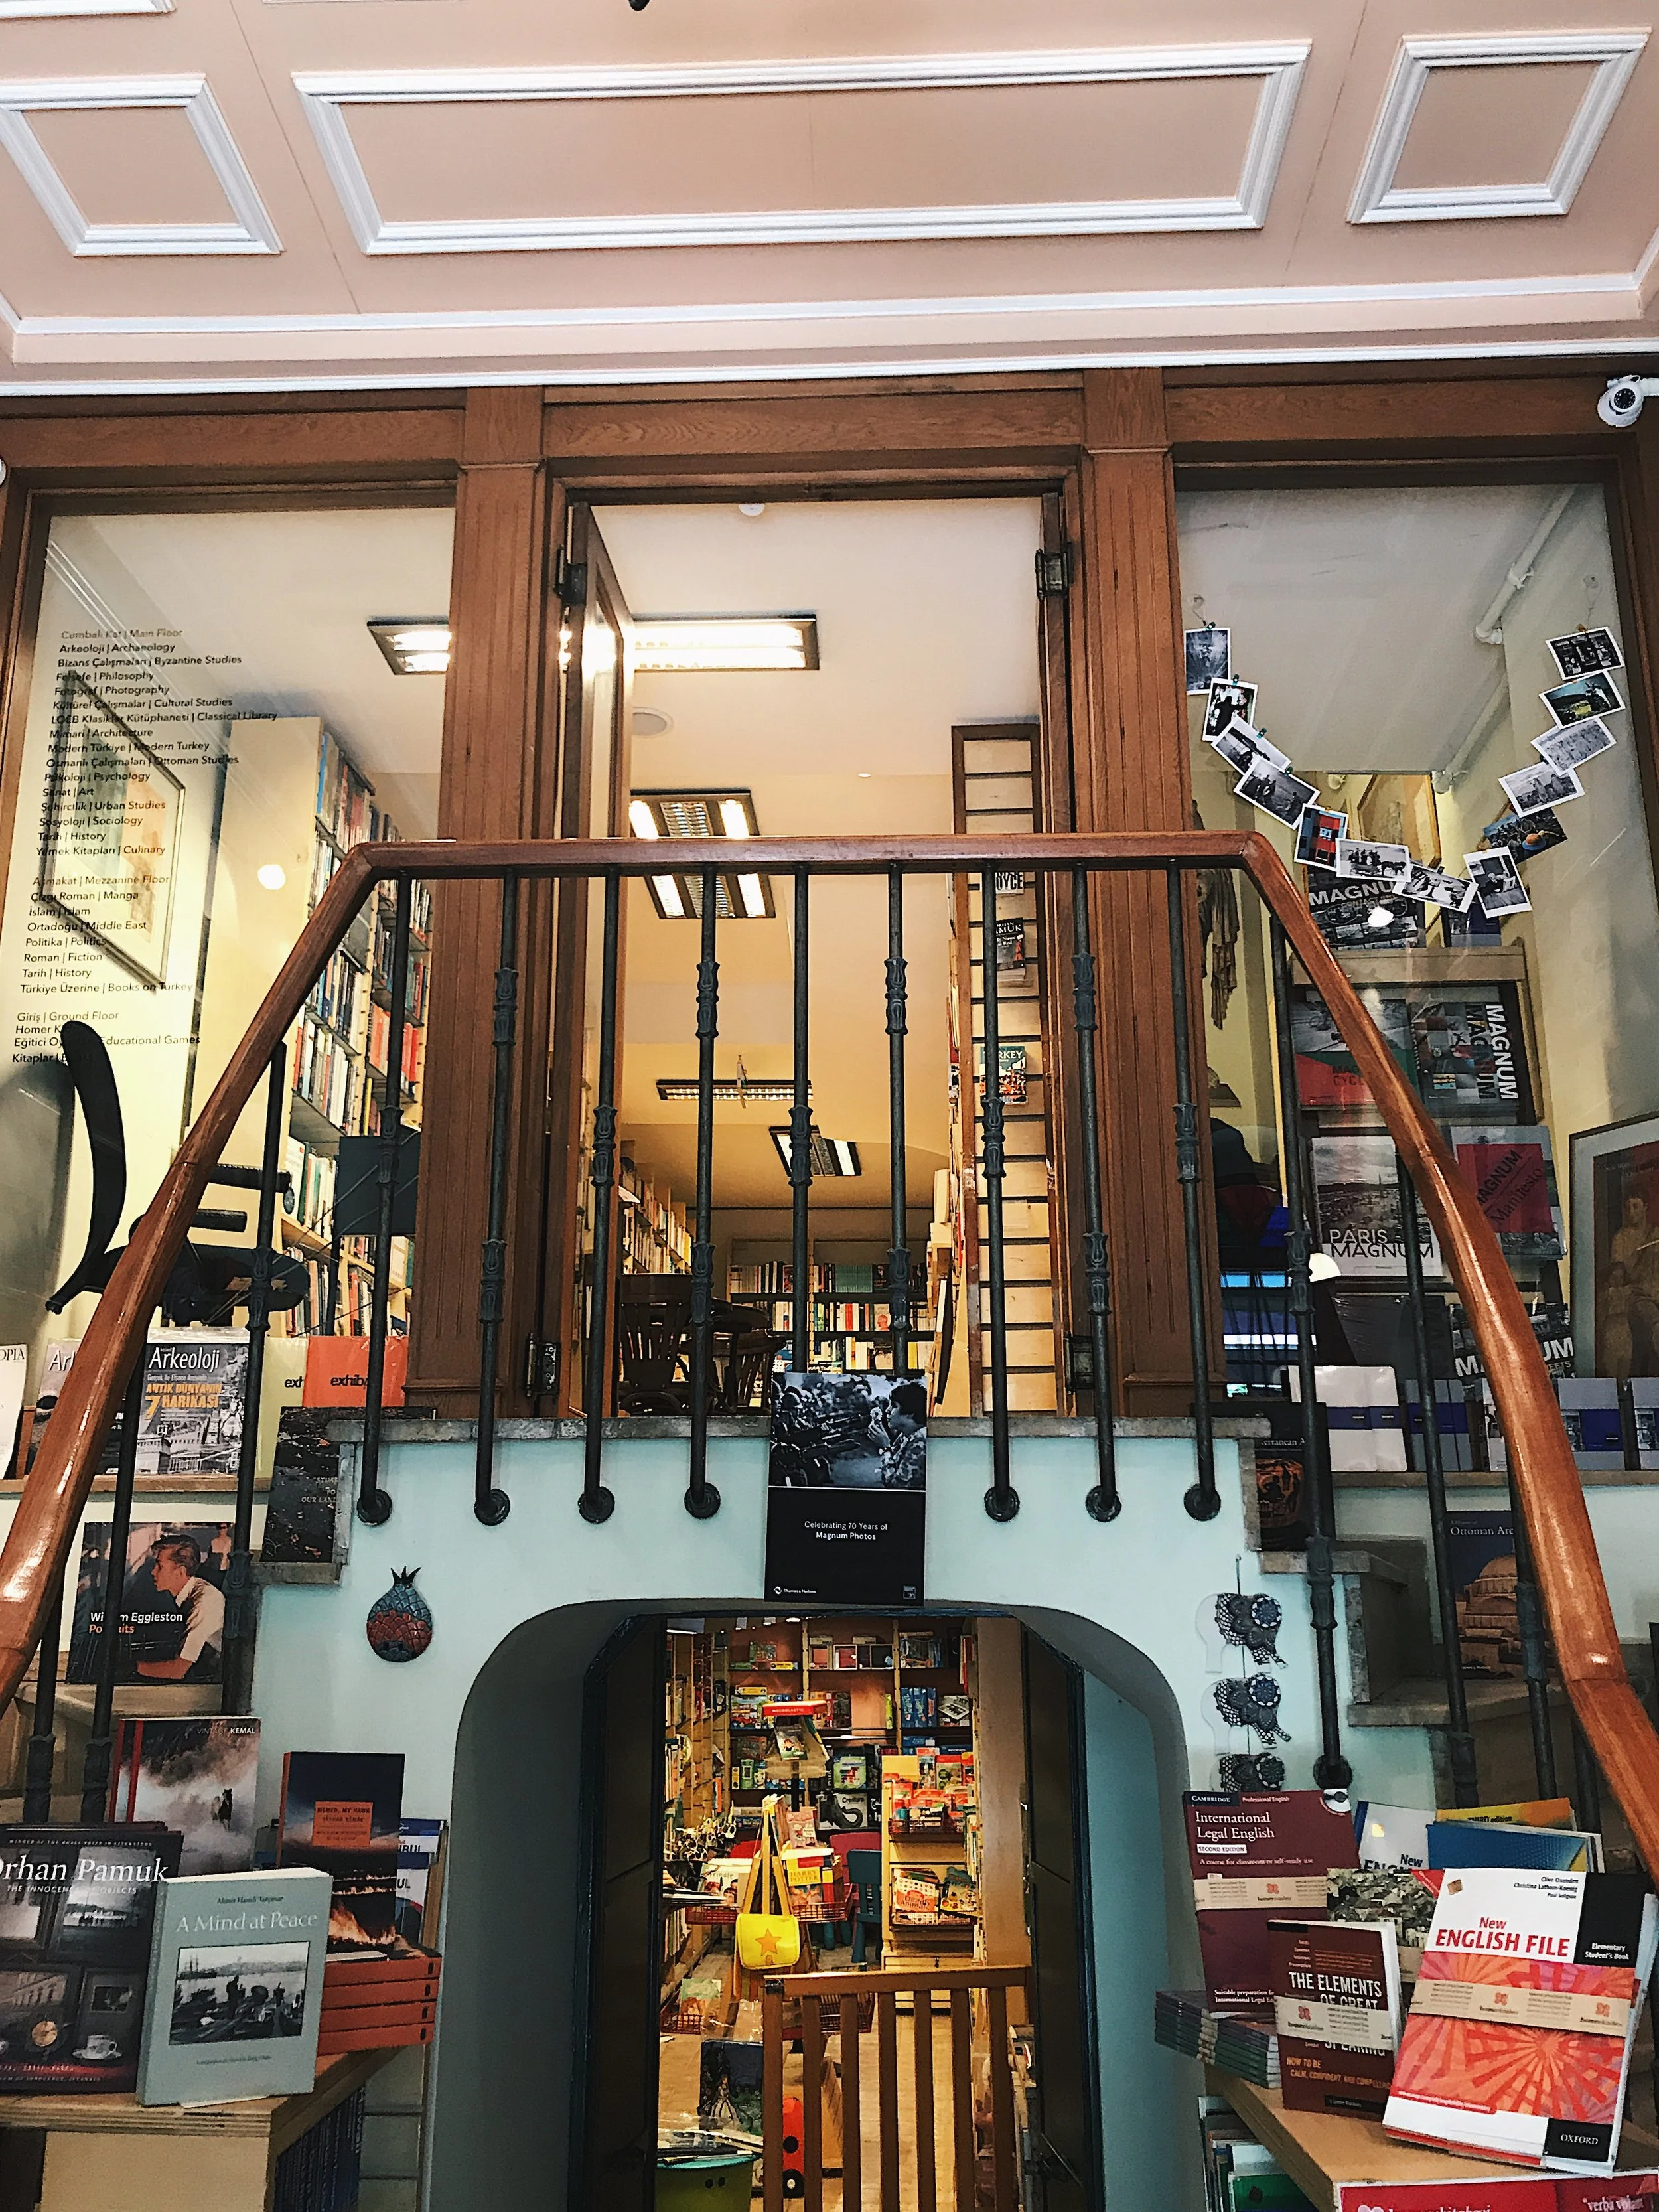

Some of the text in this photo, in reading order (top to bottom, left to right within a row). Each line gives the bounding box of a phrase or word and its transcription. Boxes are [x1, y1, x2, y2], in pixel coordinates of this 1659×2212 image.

[157, 628, 182, 637] Floor
[59, 645, 105, 654] Arkeoloji
[58, 658, 89, 667] Bizans
[155, 657, 202, 667] Byzantine
[100, 672, 154, 682] Philosophy
[105, 685, 170, 696] Photography
[154, 698, 193, 707] Cultural
[196, 698, 233, 707] Studies
[197, 712, 240, 721] Classical
[243, 710, 277, 721] Library
[92, 729, 153, 738] Architecture
[177, 741, 209, 751] Turkey
[155, 756, 198, 765] Ottoman
[202, 754, 239, 764] Studies
[94, 772, 150, 783] Psychology
[78, 788, 94, 796] Art
[94, 801, 125, 810] Urban
[128, 800, 165, 810] Studies
[39, 816, 143, 827] Sosyoloji Sociology
[71, 831, 106, 842] History
[123, 845, 165, 857] Culinary
[85, 876, 139, 885] Mezzanine
[142, 875, 170, 884] Floor
[60, 891, 96, 901] Roman
[104, 891, 139, 901] Manga
[1309, 881, 1394, 906] MAGNU
[86, 921, 147, 930] Middle East
[25, 936, 106, 947] Politika Politics
[24, 952, 102, 962] Roman Fiction
[22, 968, 92, 980] Tarih History
[21, 981, 194, 995] Türkiye Üzerine Books on Turkey
[17, 1011, 119, 1024] Giriş Ground Floor
[15, 1025, 52, 1035] Homer
[14, 1037, 46, 1049] Eğitici
[164, 1035, 200, 1045] Games
[1485, 1005, 1519, 1099] MAGNUM
[13, 1053, 54, 1065] Kitaplar
[1490, 1168, 1543, 1225] Manifesto
[1329, 1229, 1388, 1244] PARIS
[148, 1347, 220, 1372] Arkeoloji
[144, 1395, 161, 1420] 7
[804, 1520, 847, 1530] Celebrating
[816, 1531, 876, 1540] Magnum Photos
[1451, 1526, 1494, 1536] Ottoman
[131, 1612, 183, 1623] Eggleston
[1196, 1811, 1271, 1824] International
[1197, 1827, 1275, 1842] Legal English
[1400, 1854, 1423, 1868] New
[75, 1858, 169, 1882] Pamuk
[176, 1911, 317, 1933] A Mind at Peace
[1479, 1917, 1507, 1929] New
[1435, 1929, 1571, 1957] ENGLISH FILE
[1591, 1943, 1625, 1952] Elementary
[1585, 1951, 1629, 1960] Student's Book
[1289, 1972, 1382, 1998] THE ELEMENTS
[1287, 2057, 1321, 2069] HOW TO BE
[1561, 2134, 1598, 2145] OXFORD
